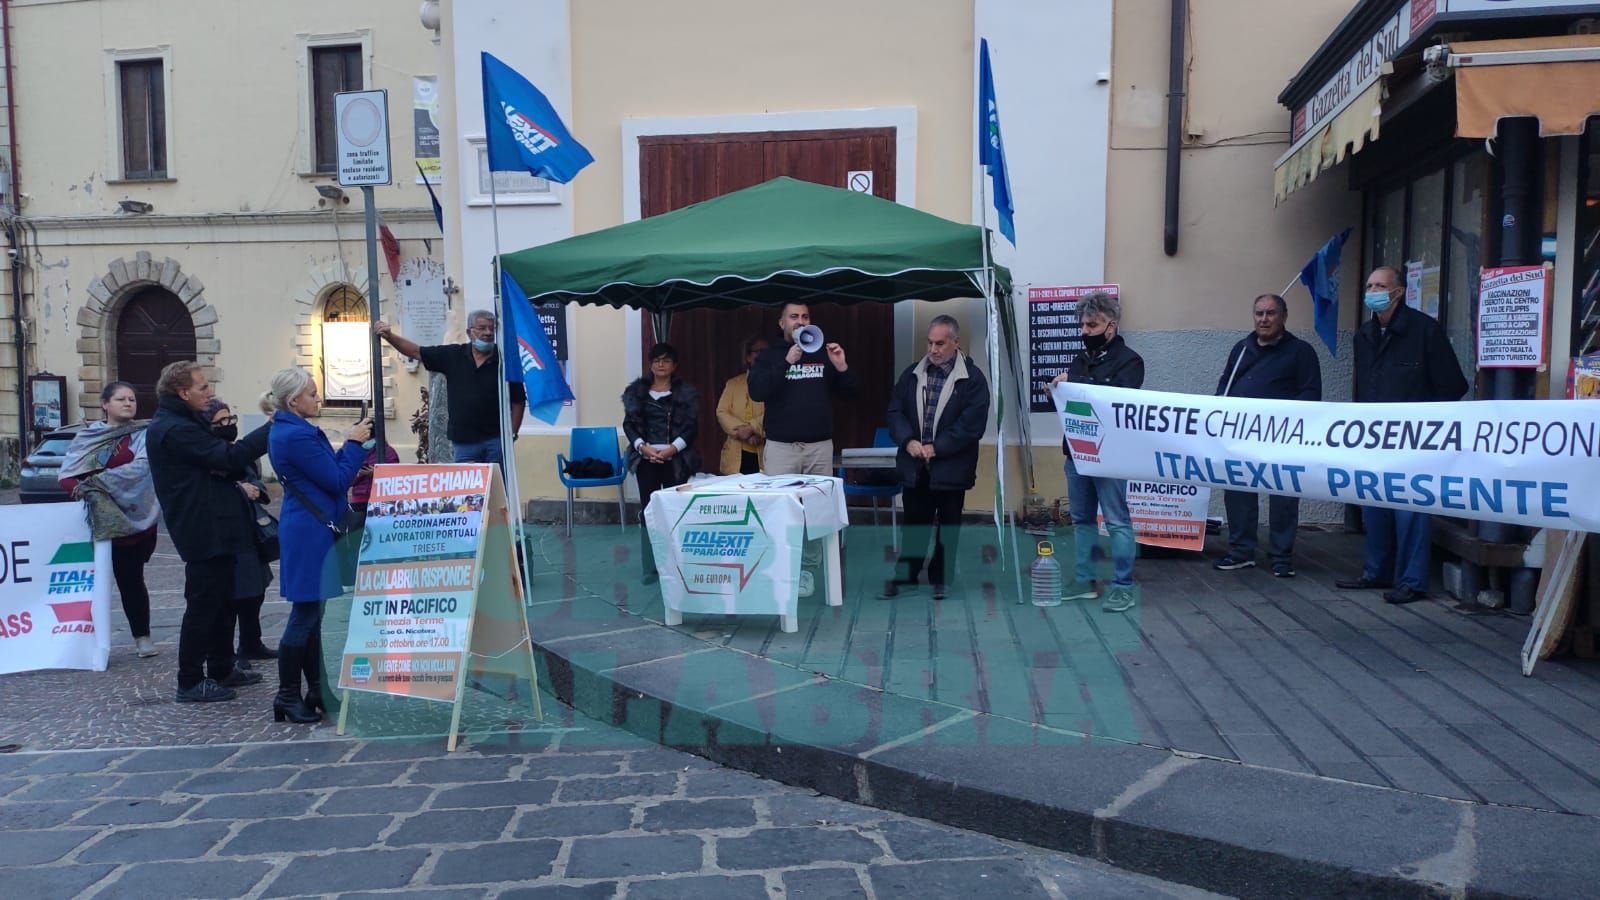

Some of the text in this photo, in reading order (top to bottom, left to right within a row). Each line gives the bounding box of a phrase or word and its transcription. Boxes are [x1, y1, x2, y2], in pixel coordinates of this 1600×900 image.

[1312, 10, 1400, 125] Gazzetta del Sud
[1525, 270, 1543, 280] Sud
[1065, 418, 1099, 432] ITALEXIT
[1112, 402, 1201, 435] TRIESTE
[1472, 420, 1600, 457] RISPON
[1073, 453, 1100, 463] CALABRIA
[375, 469, 484, 497] TRIESTE CHIAMA
[1129, 482, 1197, 496] IN PACIFICO
[1155, 451, 1570, 518] ITALEXIT PRESENTE
[699, 504, 737, 514] PER L'ITALIA
[1136, 508, 1160, 516] ottobre
[393, 517, 468, 529] COORDINAMENTO
[379, 528, 477, 543] LAVORATORI PORTUALI
[683, 531, 754, 549] ITALEXIT
[413, 543, 446, 553] TRIESTE
[693, 547, 748, 557] PARAGONE
[360, 565, 472, 591] LA CALABRIA RISPONDE
[694, 574, 731, 584] NO EUROPA
[48, 584, 93, 595] PER L'IT
[363, 598, 457, 616] SIT IN PACIFICO
[373, 617, 444, 626] Lamezia Terme
[366, 637, 449, 648] sab 30 ottobre ore 17.00
